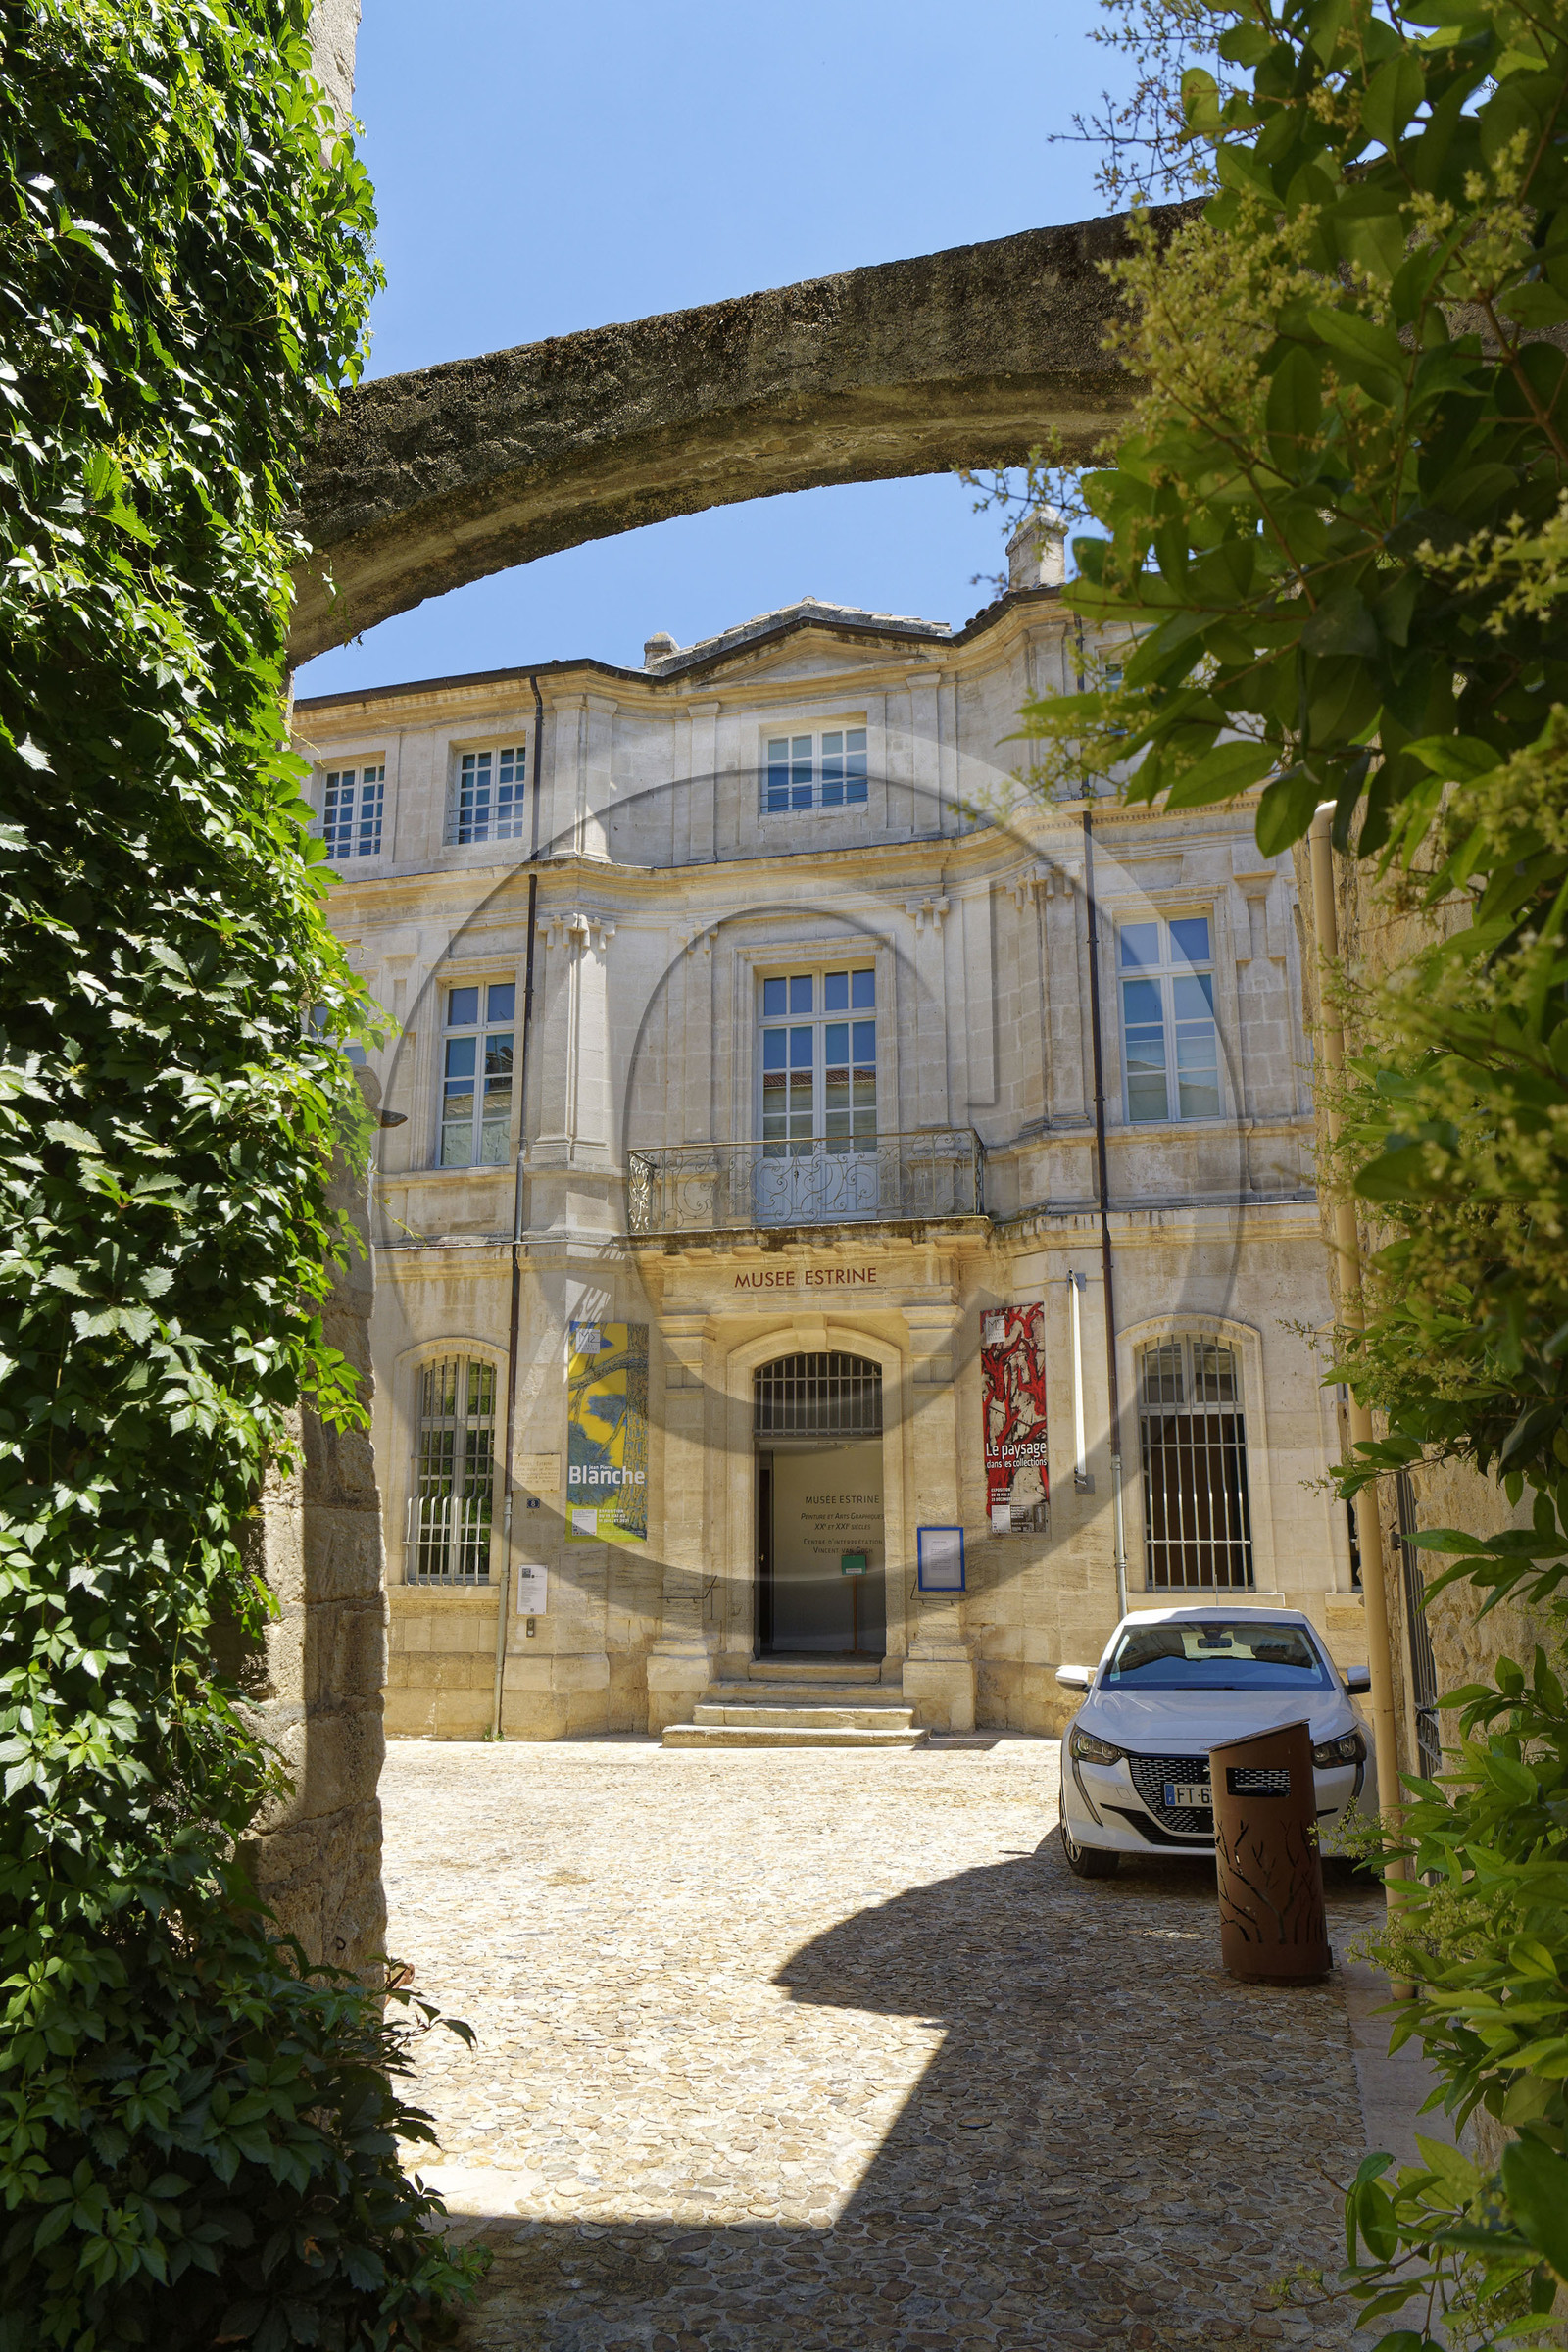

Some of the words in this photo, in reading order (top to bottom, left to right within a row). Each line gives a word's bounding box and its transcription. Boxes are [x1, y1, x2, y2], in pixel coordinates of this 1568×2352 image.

[734, 1271, 795, 1288] MUSEE
[805, 1267, 877, 1285] ESTRINE
[986, 1443, 999, 1456] Le
[1002, 1442, 1047, 1459] paysage
[1003, 1459, 1012, 1468] les
[1012, 1458, 1048, 1467] collections
[568, 1465, 645, 1484] Blanche
[805, 1494, 837, 1504] MUSÉE
[839, 1495, 880, 1504] ESTRINE
[1176, 1788, 1212, 1803] FT-6
